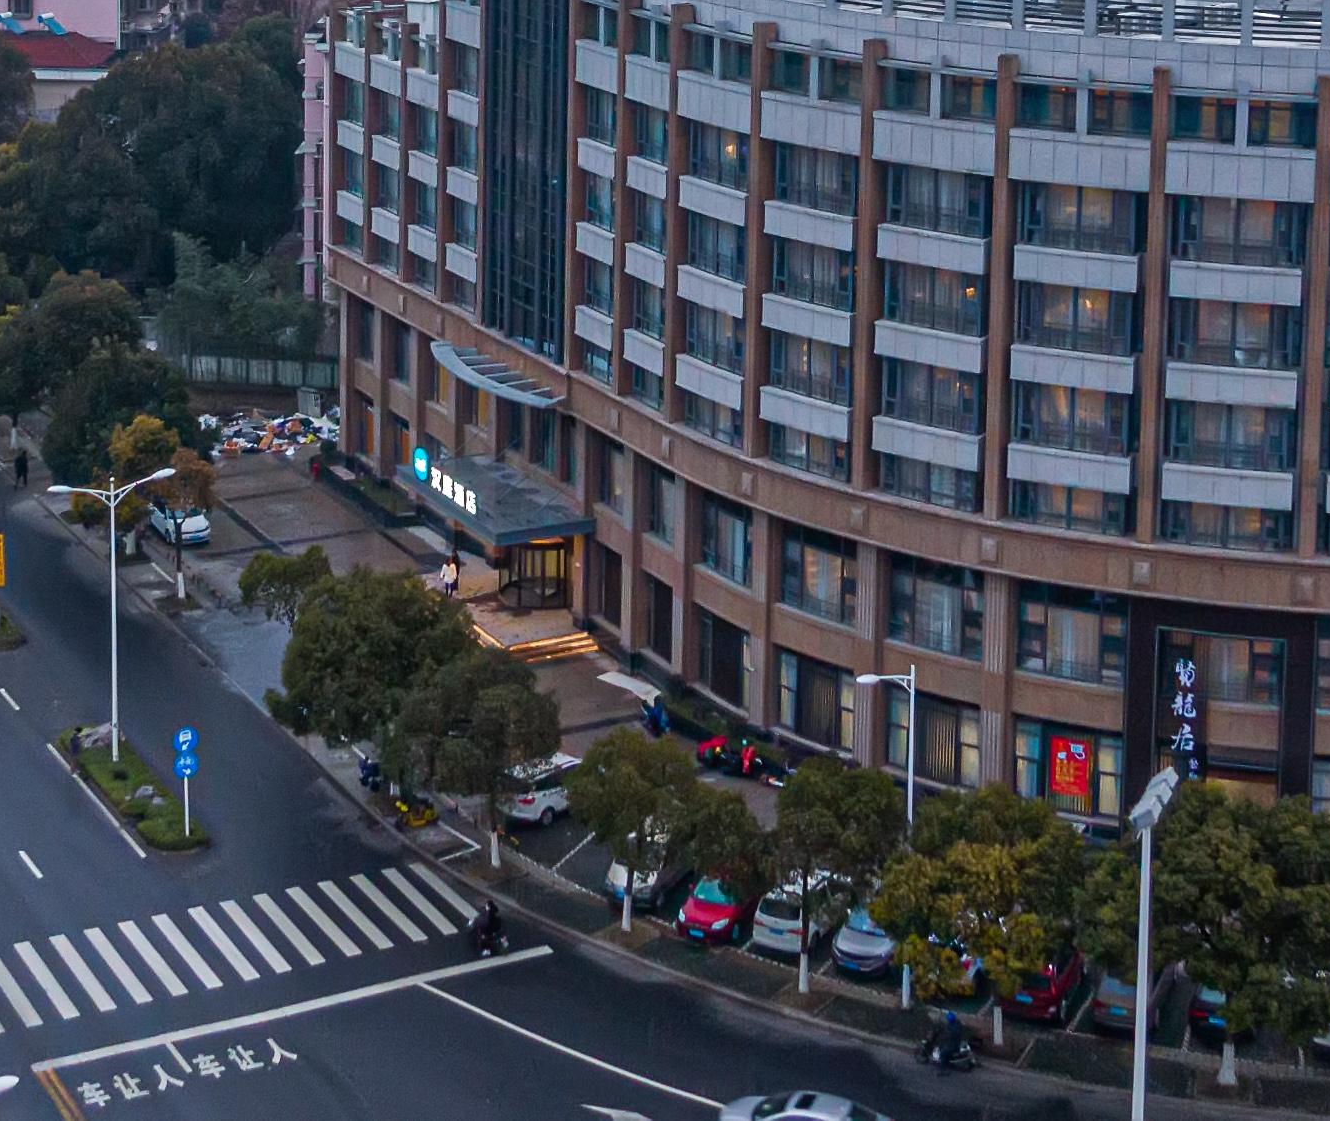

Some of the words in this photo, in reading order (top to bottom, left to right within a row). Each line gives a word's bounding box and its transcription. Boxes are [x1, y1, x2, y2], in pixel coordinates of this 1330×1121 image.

[192, 1038, 298, 1079] 车让人
[77, 1063, 185, 1107] 车让人
